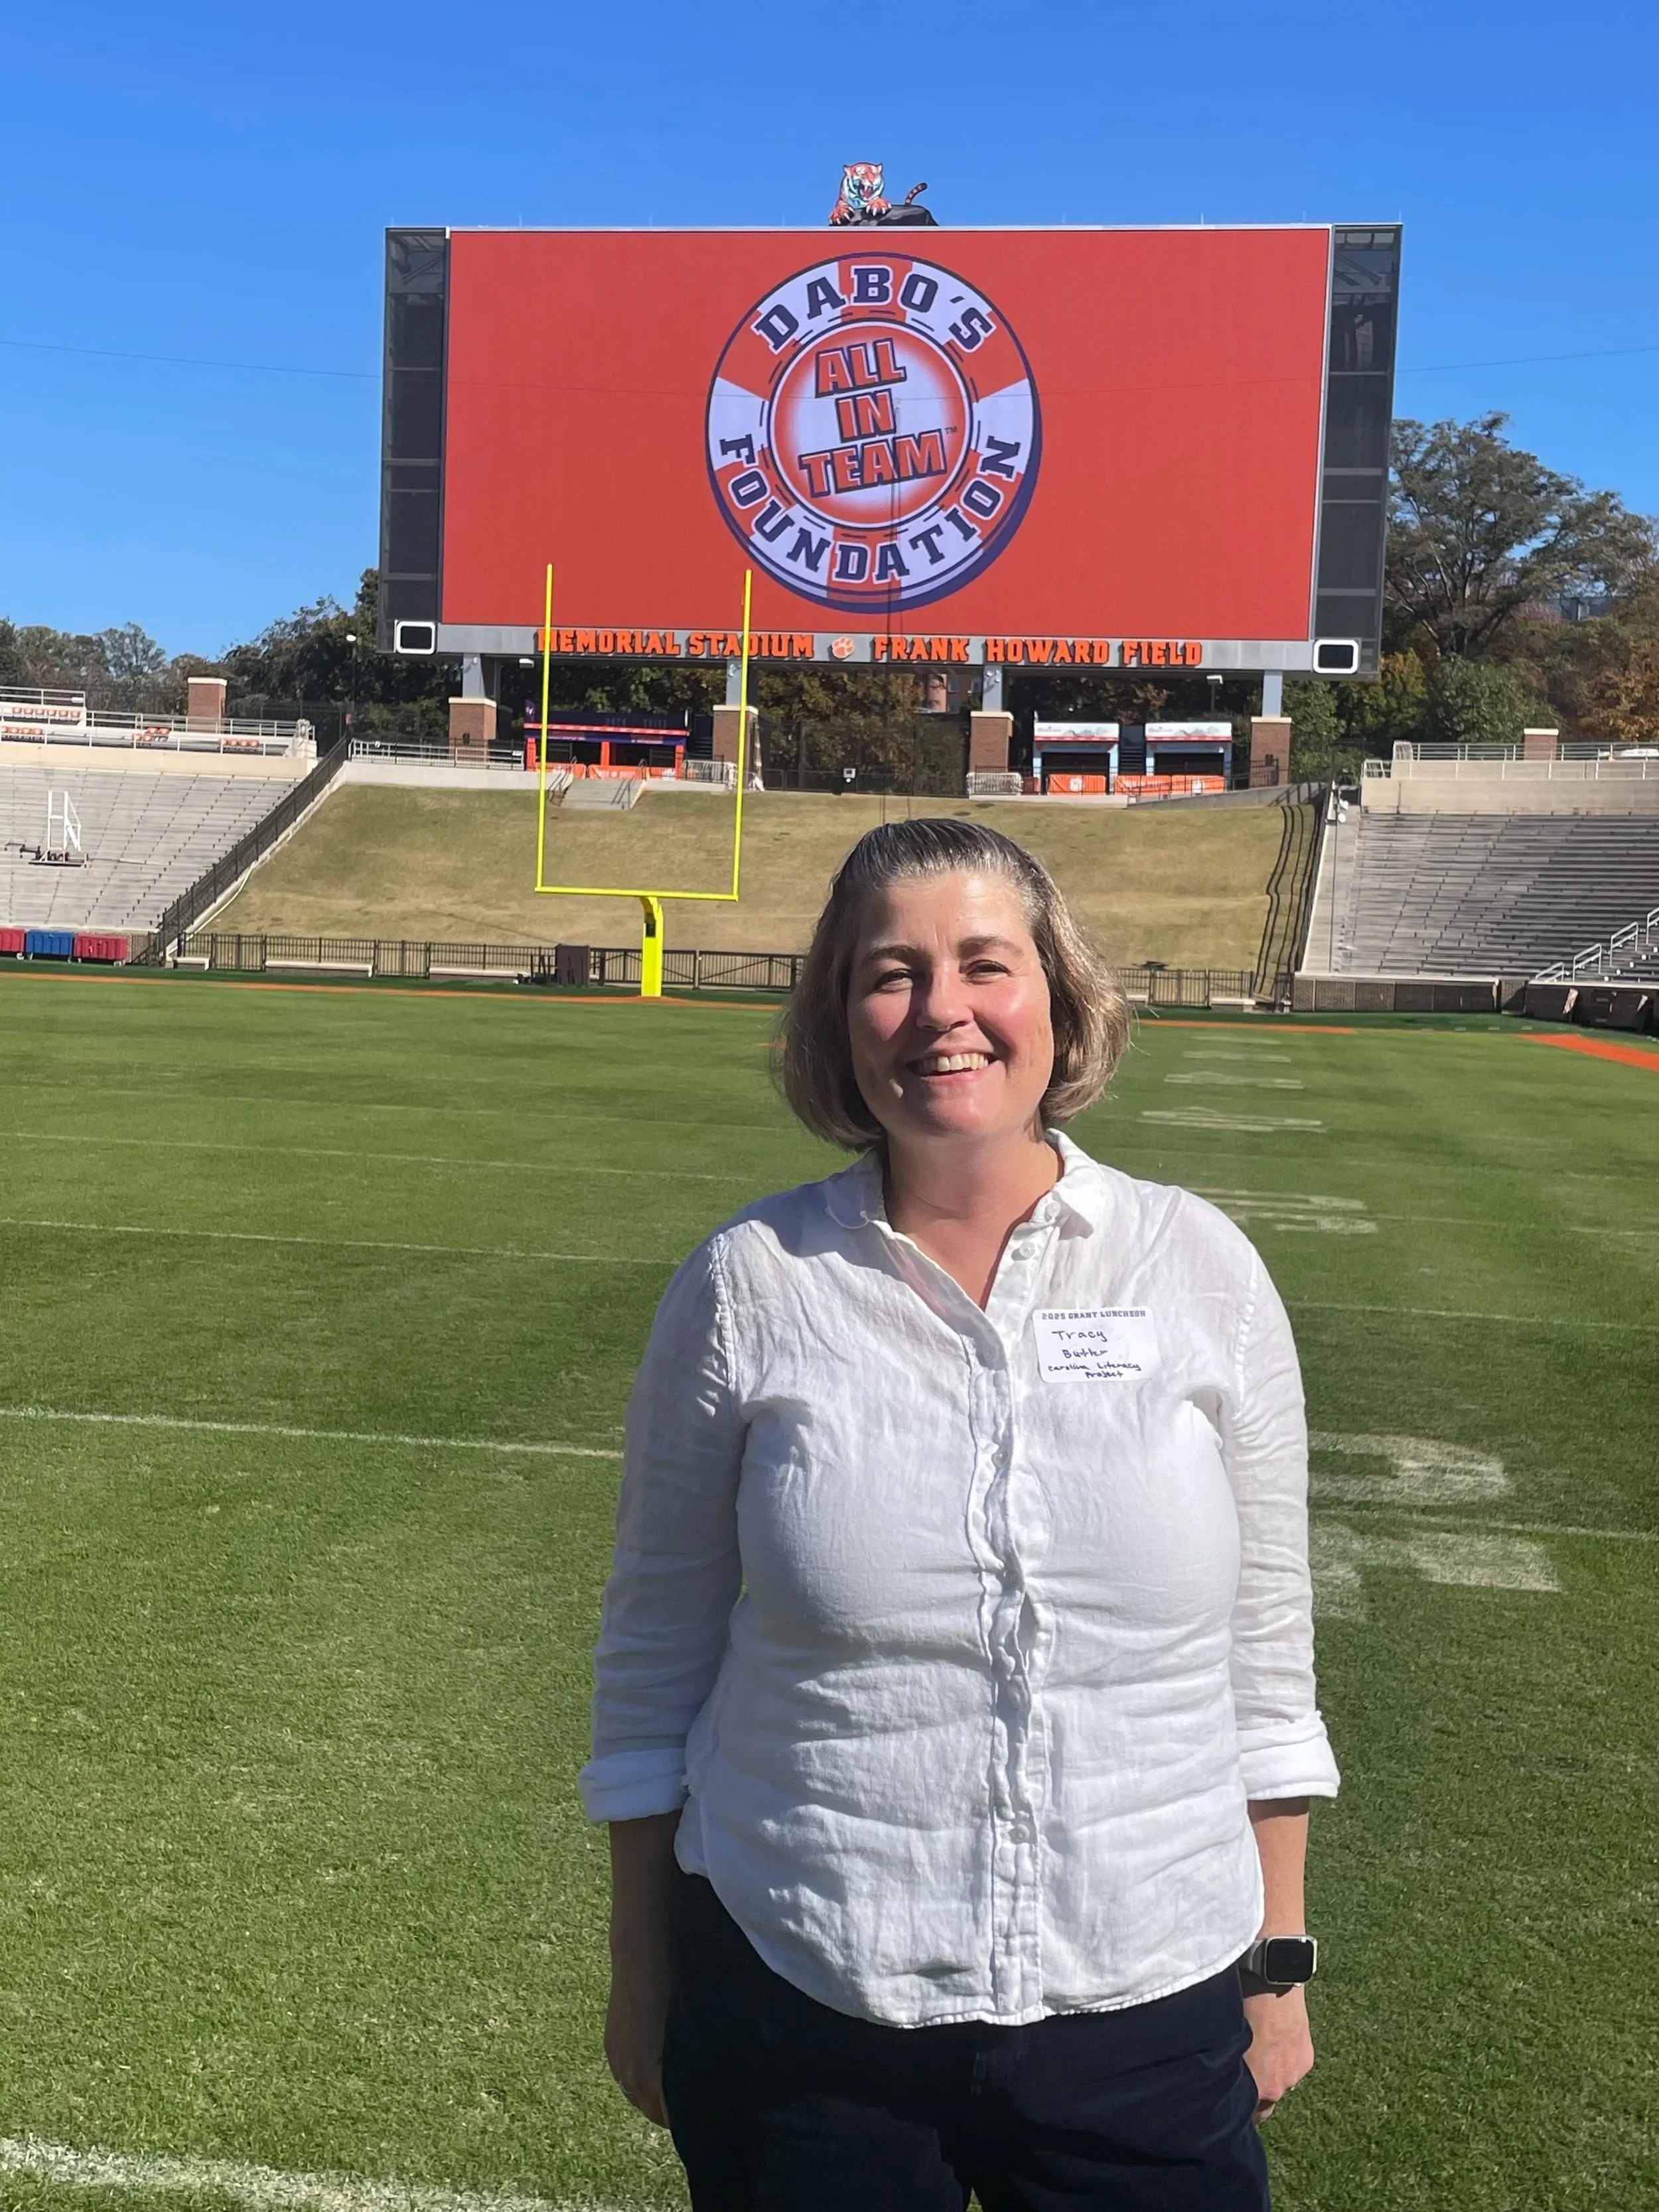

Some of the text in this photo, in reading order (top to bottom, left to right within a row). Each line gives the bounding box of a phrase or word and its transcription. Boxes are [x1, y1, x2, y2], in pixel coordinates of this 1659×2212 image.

[755, 267, 994, 351] DABO'S
[815, 338, 906, 398] ALL
[835, 389, 897, 443] IN
[799, 429, 947, 498] TEAM
[720, 434, 1021, 581] FOUNDATION
[536, 628, 1202, 666] MEMORIAL STADIUM FRANK HOWARD FIELD
[1052, 1331, 1108, 1342] Tracy
